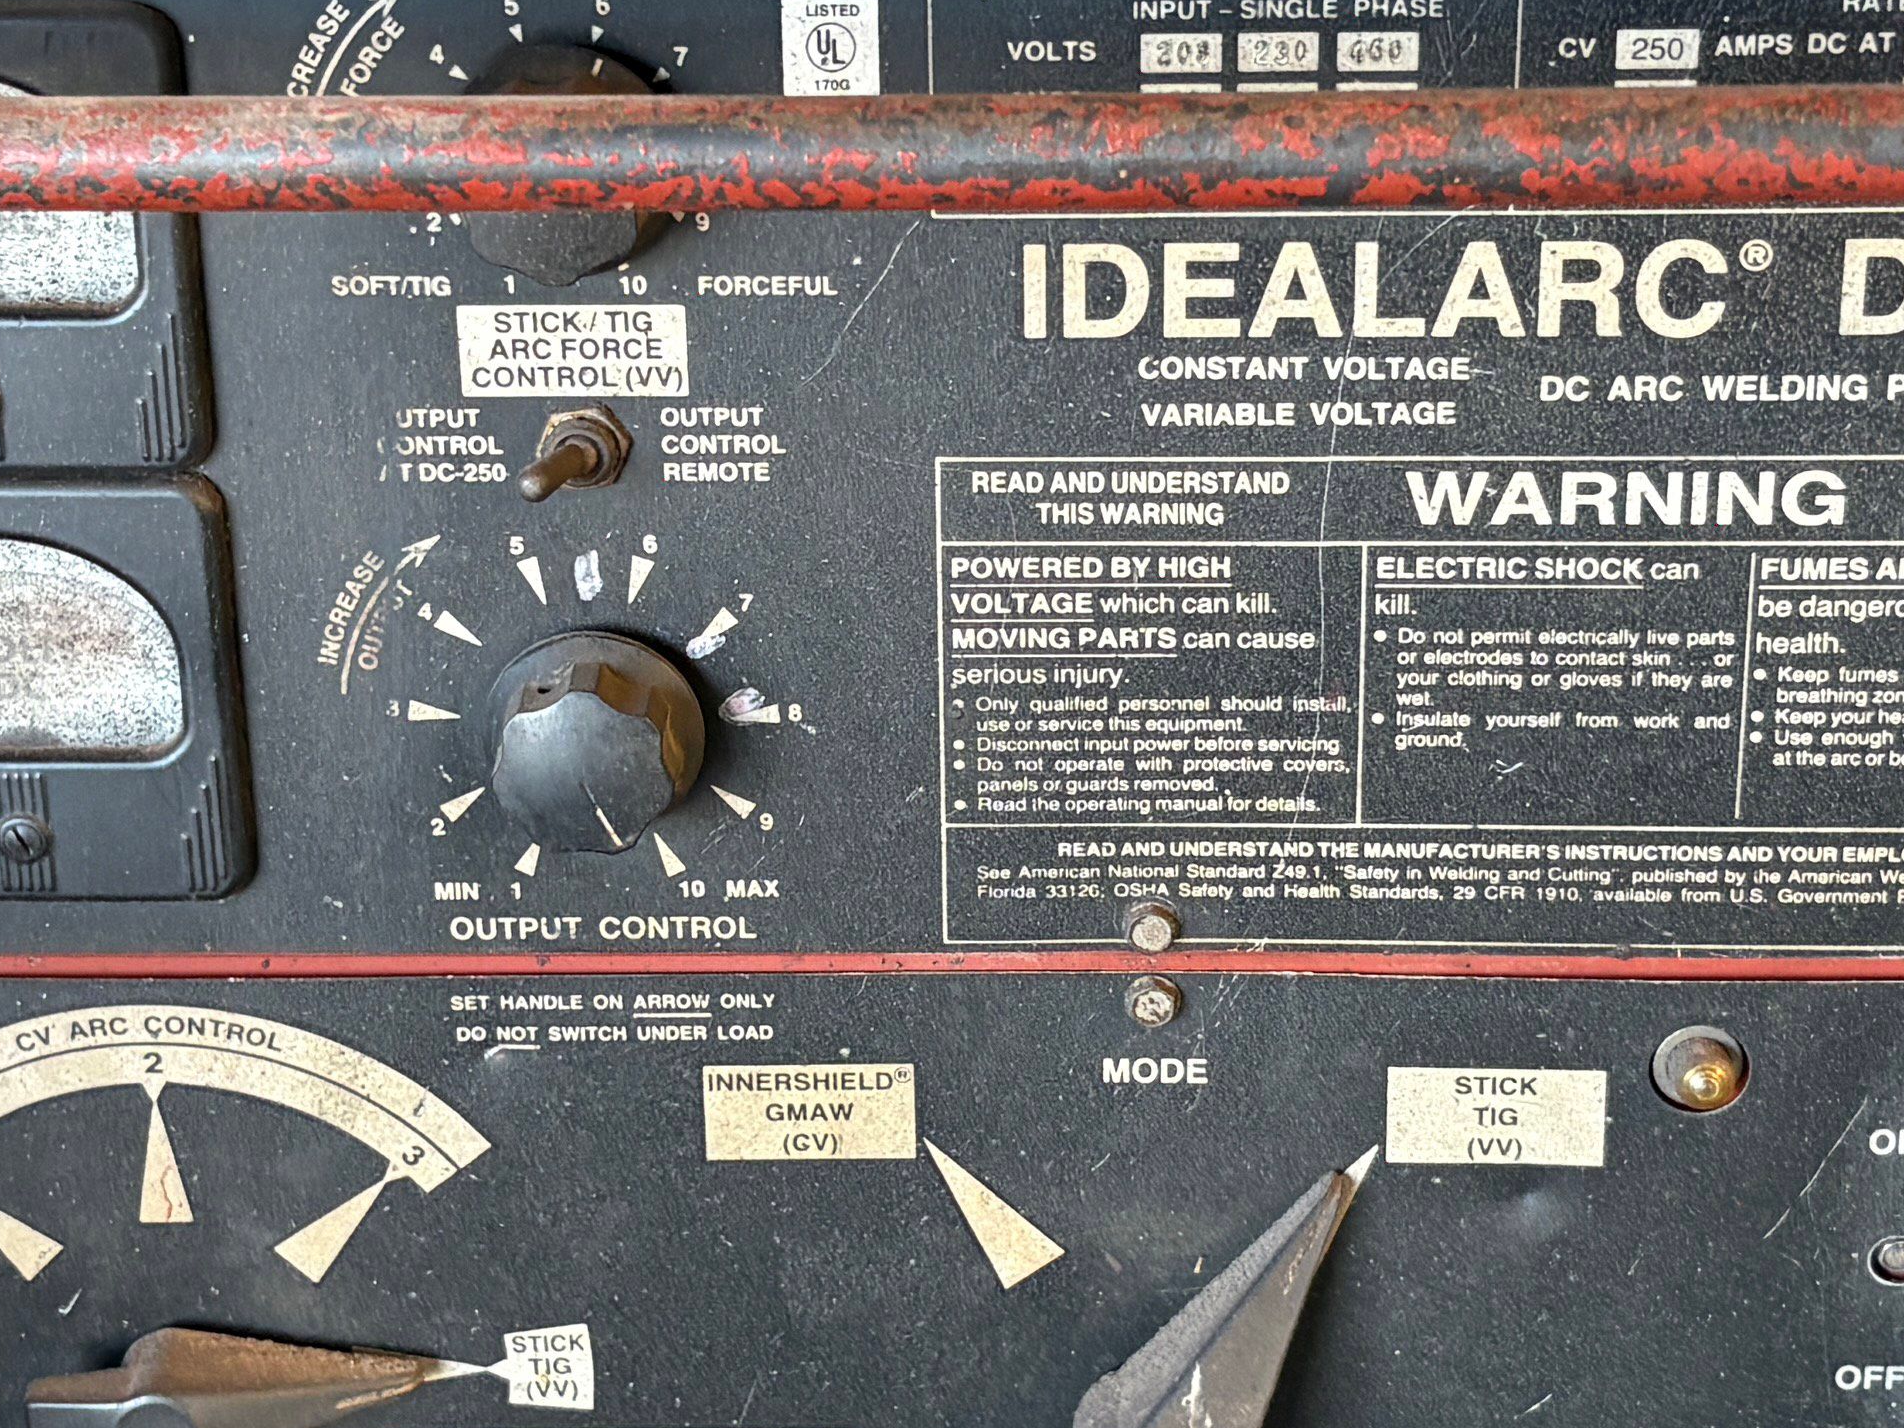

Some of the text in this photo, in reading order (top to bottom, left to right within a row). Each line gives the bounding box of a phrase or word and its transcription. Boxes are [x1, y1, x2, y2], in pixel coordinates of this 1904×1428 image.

[806, 4, 860, 16] LISTED
[1133, 0, 1211, 20] INPUT
[817, 29, 845, 64] UL
[1007, 41, 1096, 61] VOLTS
[1559, 38, 1596, 58] CV
[1631, 38, 1683, 60] 250
[1715, 32, 1895, 56] AMPS DC AT
[698, 276, 838, 296] FORCEFUL
[494, 311, 652, 333] STICK TIG
[489, 338, 662, 360] ARC FORCE
[472, 366, 682, 392] CONTROL (VV)
[1138, 355, 1470, 381] CONSTANT VOLTAGE
[1540, 376, 1589, 401] DC
[1607, 375, 1683, 401] ARC
[1702, 374, 1868, 401] WELDING
[660, 408, 763, 427] OUTPUT
[1141, 401, 1456, 426] VARIABLE VOLTAGE
[661, 435, 786, 454] CONTROL
[664, 462, 770, 482] REMOTE
[972, 471, 1290, 494] READ AND UNDERSTAND
[1406, 470, 1847, 526] WARNING
[1035, 502, 1224, 526] THIS WARNING
[952, 556, 1230, 579] POWERED BY HIGH
[1377, 557, 1699, 580] ELECTRIC SHOCK can
[1762, 557, 1869, 580] FUMES
[317, 551, 385, 665] INCREASE
[951, 592, 1276, 614] VOLTAGE which can kill.
[1375, 594, 1417, 615] kill.
[977, 736, 1339, 758] Disconnect input power before servicing
[435, 882, 481, 900] MIN
[724, 879, 779, 899] MAX
[450, 916, 757, 940] OUTPUT CONTROL
[451, 993, 774, 1010] SET HANDLE ON ARROW ONLY
[16, 1016, 283, 1051] CV ARC CONTROL
[1103, 1058, 1208, 1084] MODE
[1455, 1076, 1537, 1095] STICK
[766, 1103, 853, 1121] GMAW
[1473, 1106, 1517, 1126] TIG
[1468, 1138, 1522, 1160] (VV)
